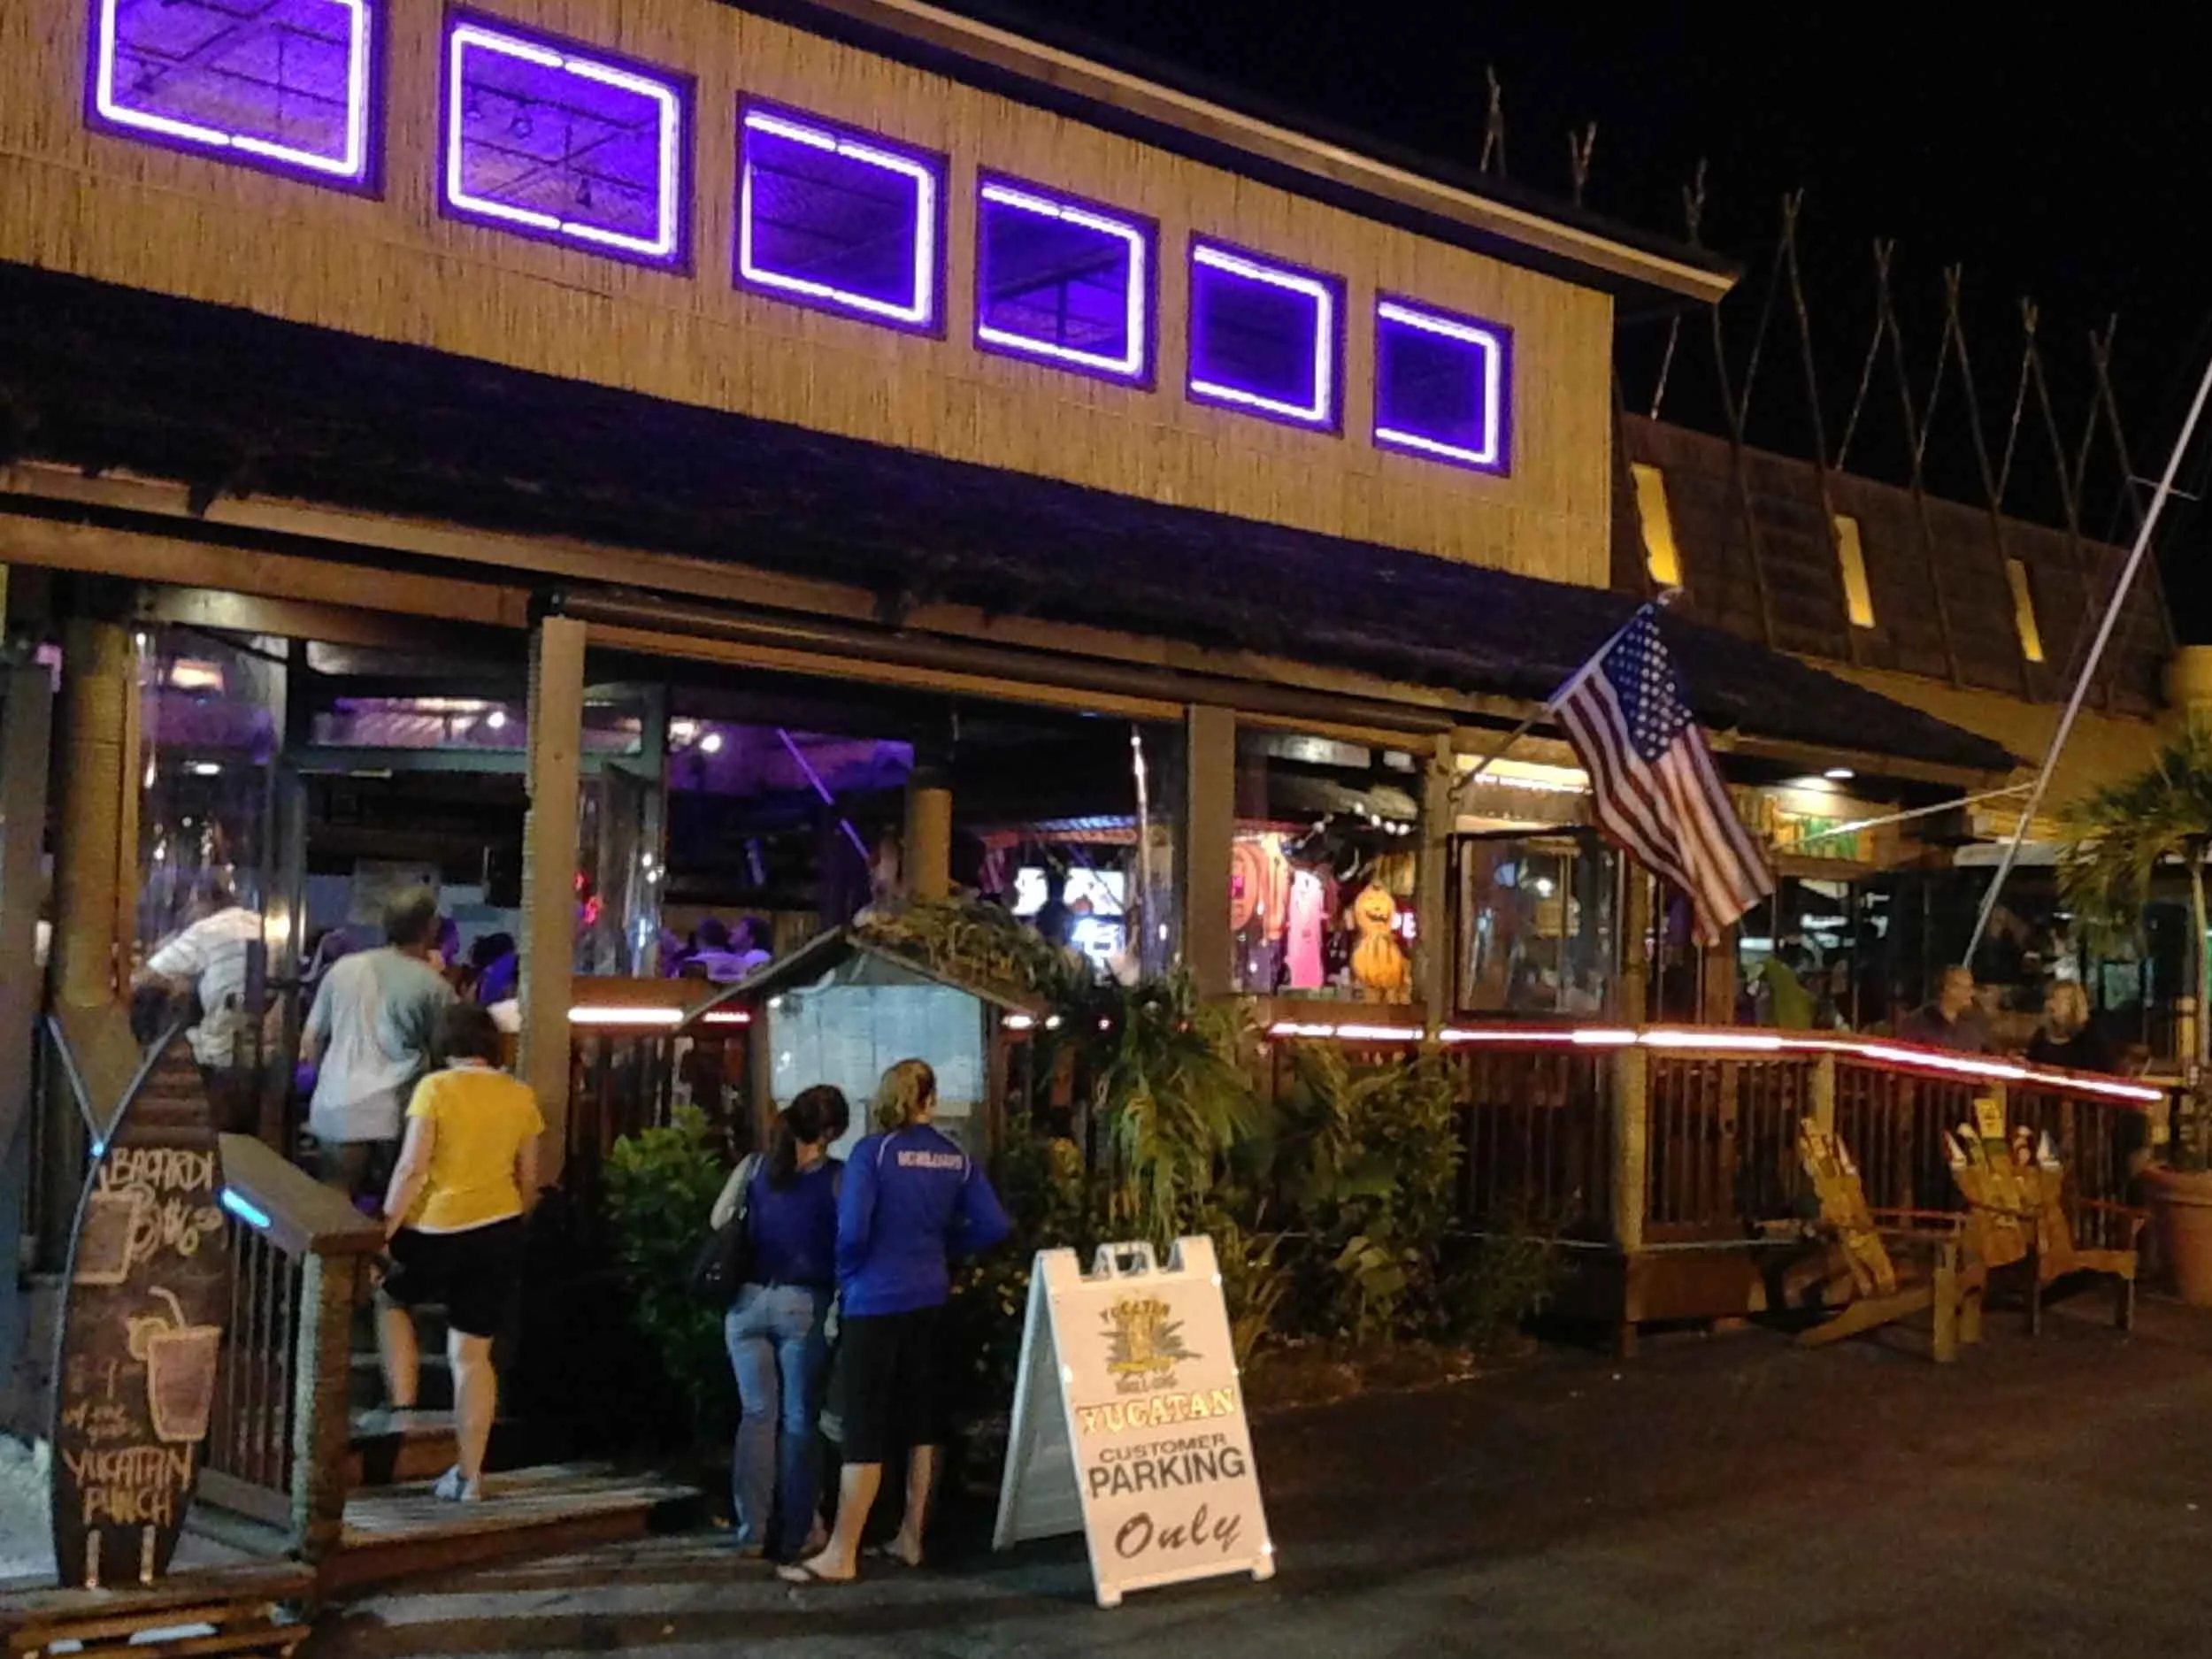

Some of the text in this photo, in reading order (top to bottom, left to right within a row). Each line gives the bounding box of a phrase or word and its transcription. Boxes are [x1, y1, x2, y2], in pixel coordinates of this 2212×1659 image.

[1076, 1388, 1234, 1434] YUCATAN
[1099, 1432, 1227, 1463] CUSTOMER
[1088, 1448, 1246, 1500] PARKING
[1114, 1503, 1241, 1559] Only
